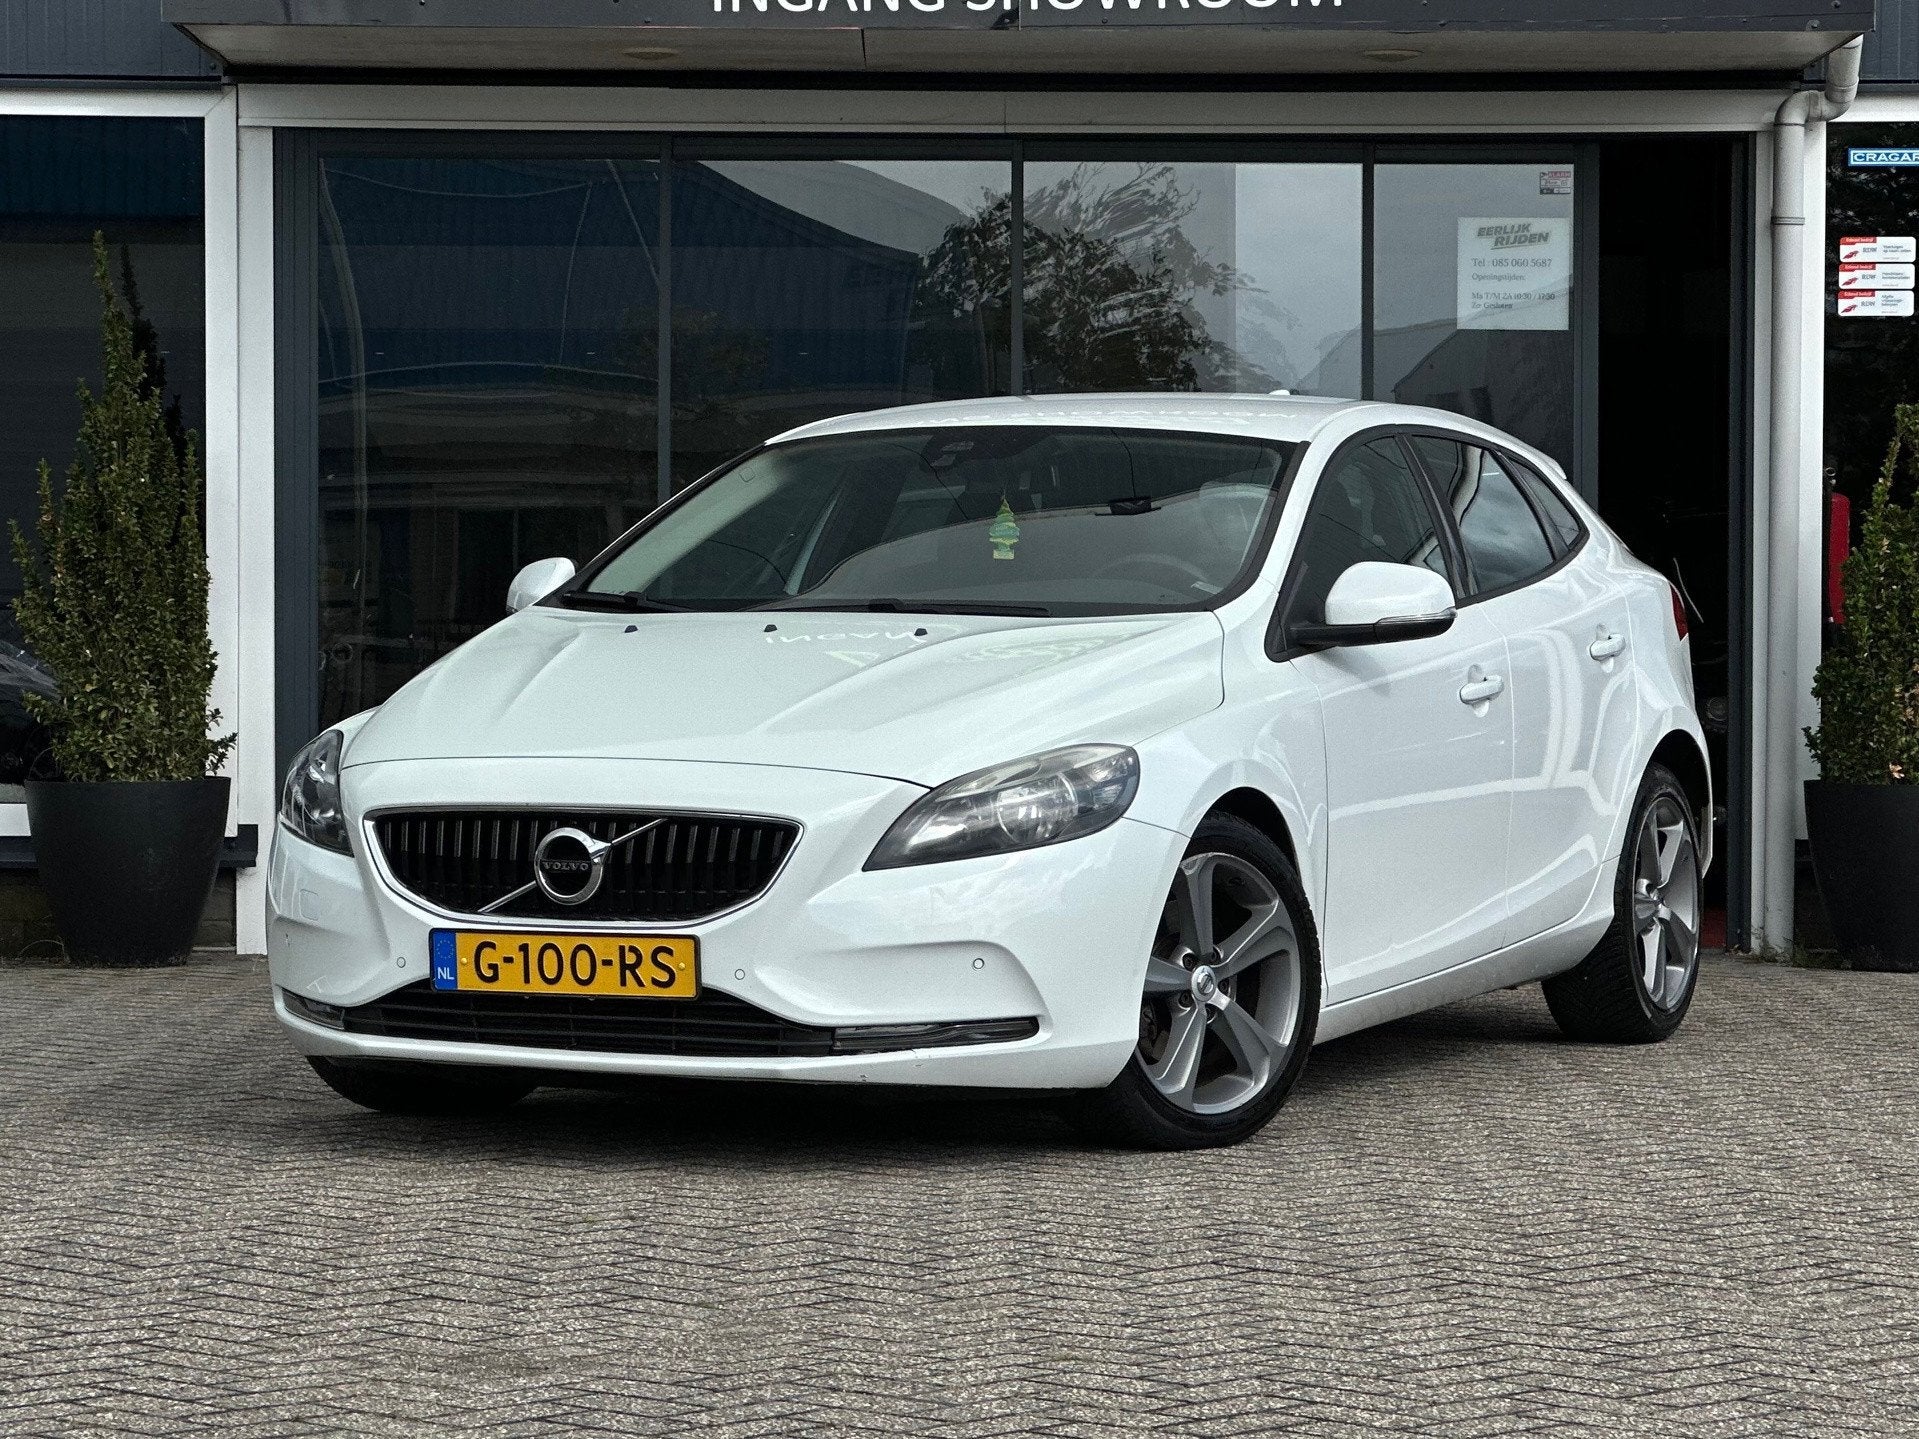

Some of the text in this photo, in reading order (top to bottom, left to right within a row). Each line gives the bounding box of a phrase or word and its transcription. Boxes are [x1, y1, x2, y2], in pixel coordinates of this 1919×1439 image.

[1477, 223, 1532, 237] EERLIJK
[1494, 232, 1550, 247] RIJDEN
[1492, 258, 1509, 267] 085
[1511, 258, 1528, 267] 060
[1531, 258, 1552, 268] 5687
[543, 861, 590, 871] VOLVO
[437, 940, 677, 989] NL G-100-RS
